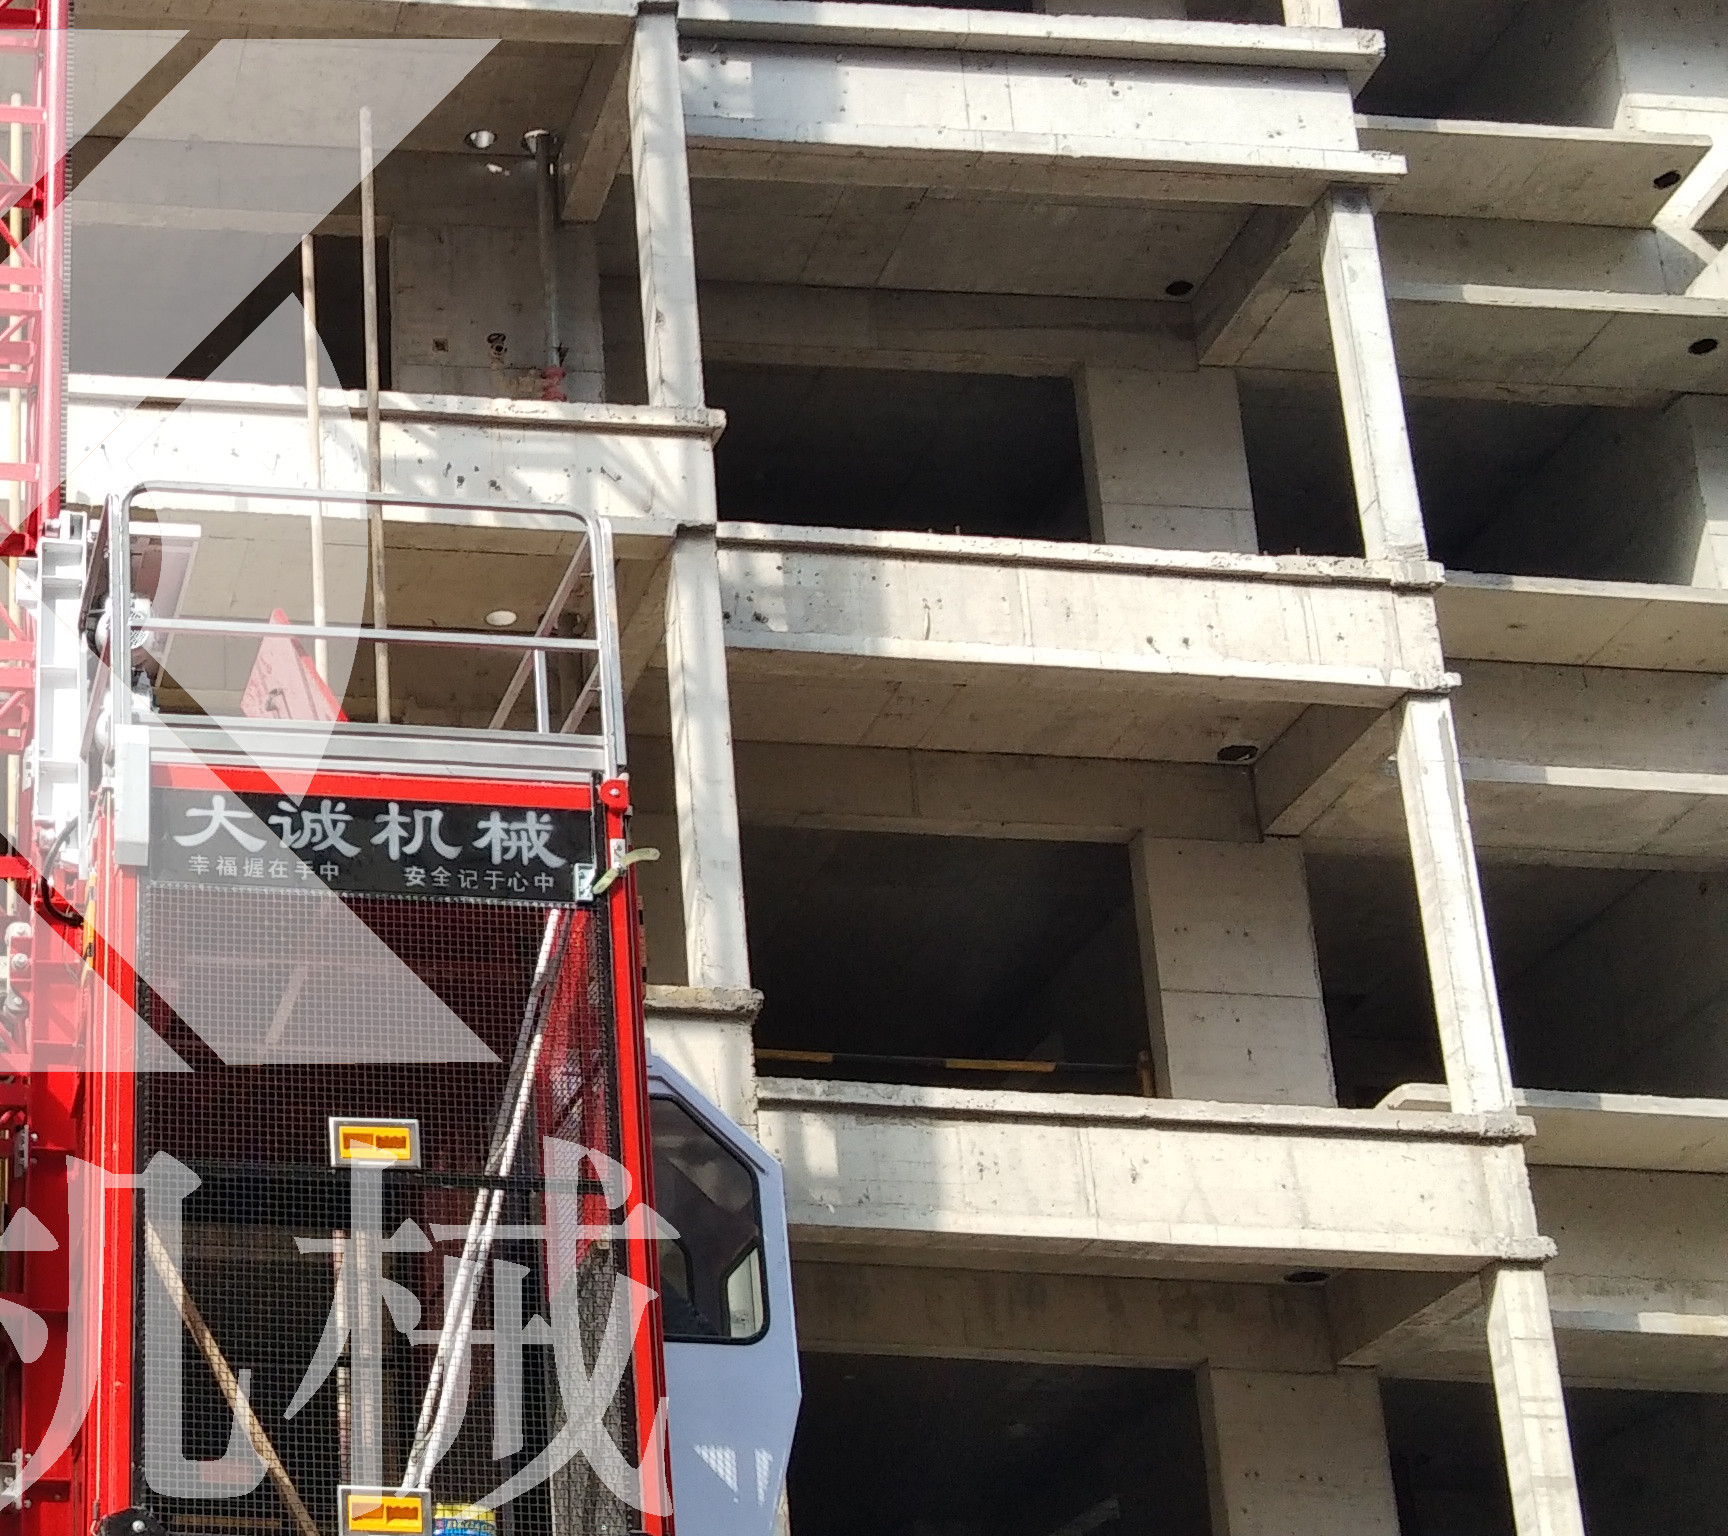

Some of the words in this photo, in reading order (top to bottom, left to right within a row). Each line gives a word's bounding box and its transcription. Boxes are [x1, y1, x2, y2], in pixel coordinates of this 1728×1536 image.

[174, 794, 567, 868] 大诚机械
[188, 854, 340, 882] 幸福握在手中
[403, 865, 555, 894] 安全记于心中
